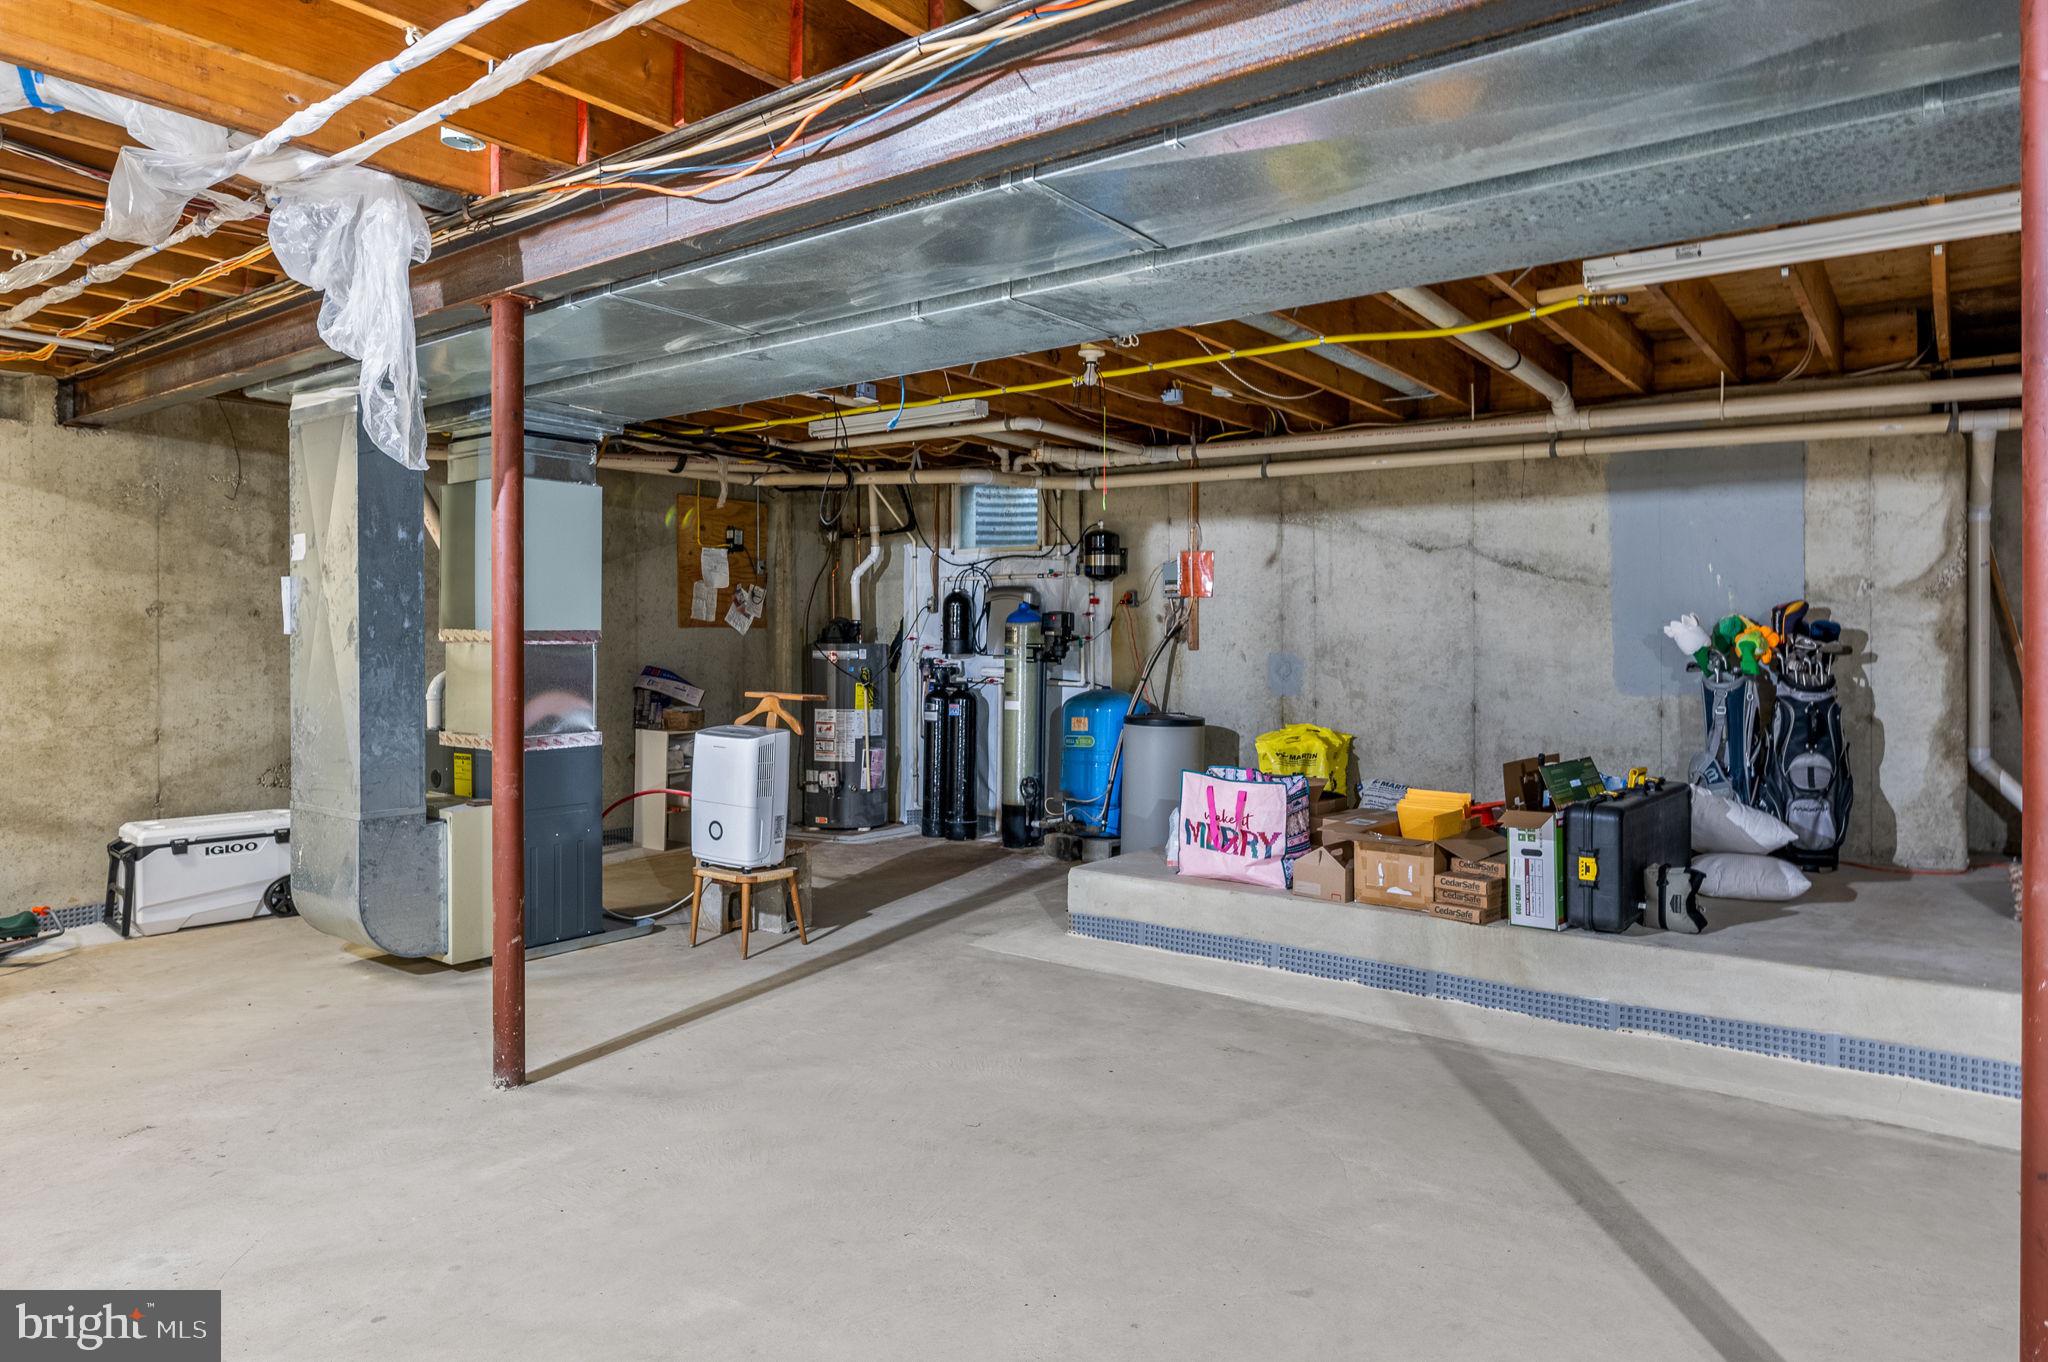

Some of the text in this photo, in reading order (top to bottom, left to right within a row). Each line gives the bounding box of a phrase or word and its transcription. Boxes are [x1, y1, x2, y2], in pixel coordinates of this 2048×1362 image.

[1289, 752, 1318, 761] MARTIN
[1380, 781, 1410, 790] MARTI
[1241, 813, 1254, 830] it
[205, 841, 258, 856] IGLOO
[1458, 860, 1499, 872] CedarSafe
[1440, 877, 1480, 890] CedarSafe
[1442, 890, 1481, 903] CedarSafe
[1434, 905, 1473, 918] CedarSafe
